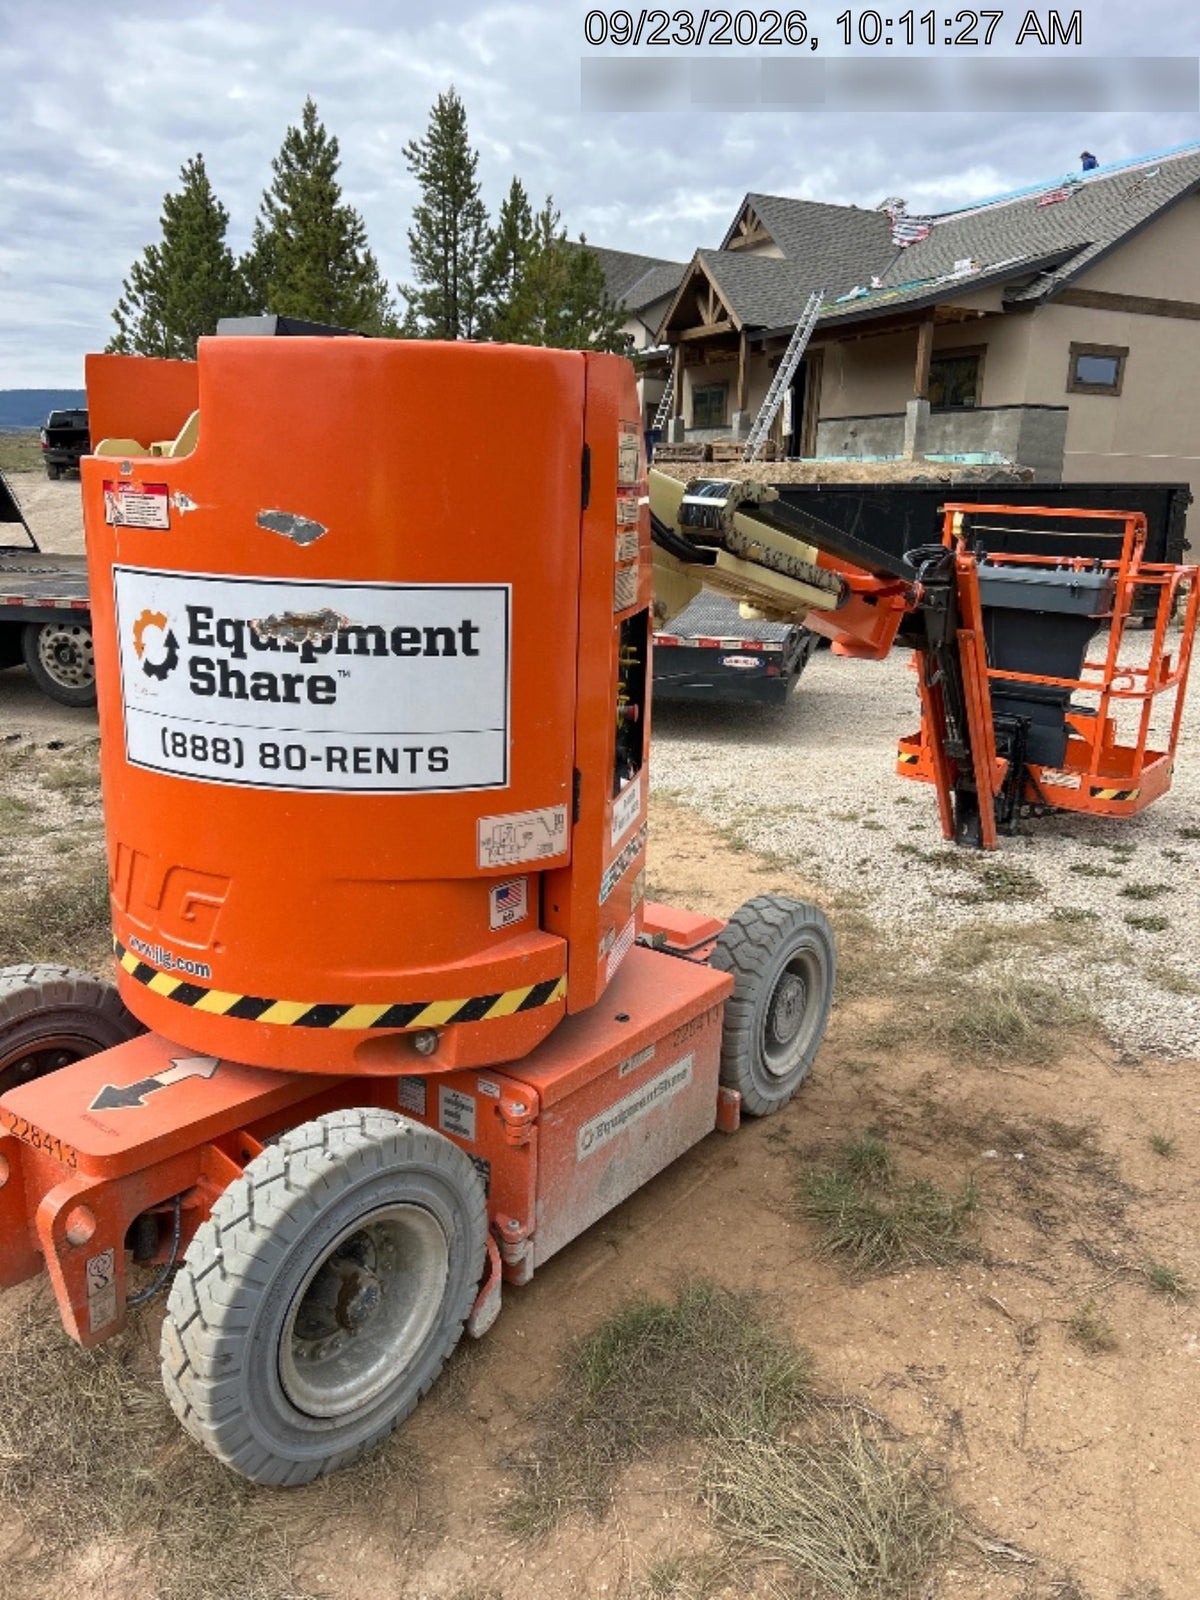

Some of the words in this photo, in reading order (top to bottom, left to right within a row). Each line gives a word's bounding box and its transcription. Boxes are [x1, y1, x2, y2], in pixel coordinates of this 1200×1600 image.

[185, 604, 480, 664] Equpment
[161, 726, 244, 769] (888)
[258, 742, 449, 774] 80-RENTS
[129, 933, 211, 978] www.jlg.com
[8, 1111, 79, 1169] 228413
